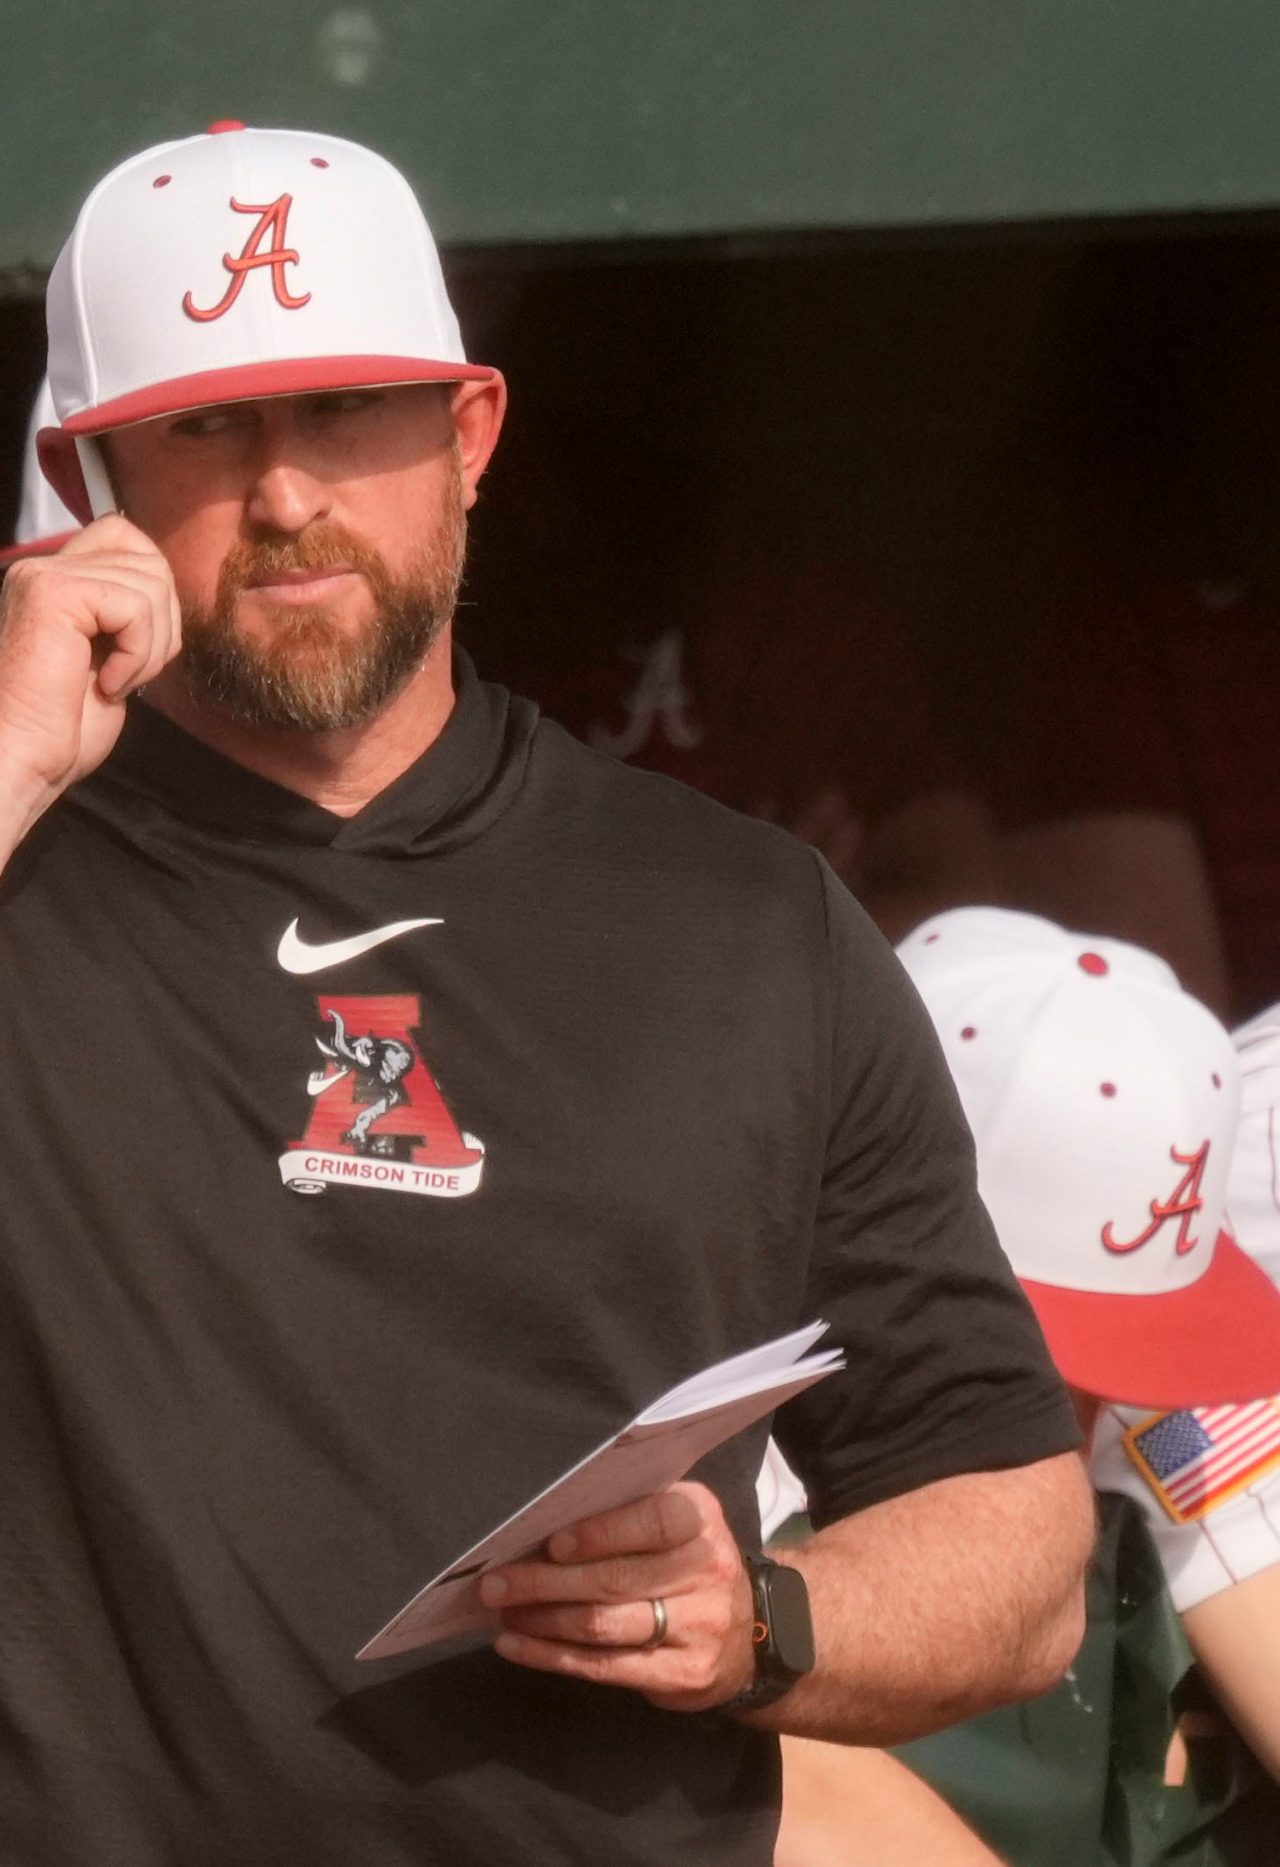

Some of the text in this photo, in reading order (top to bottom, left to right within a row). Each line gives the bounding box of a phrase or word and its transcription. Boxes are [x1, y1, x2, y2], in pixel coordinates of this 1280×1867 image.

[181, 192, 311, 323] A
[304, 1156, 460, 1190] CRIMSON TIDE
[1101, 1139, 1211, 1256] A
